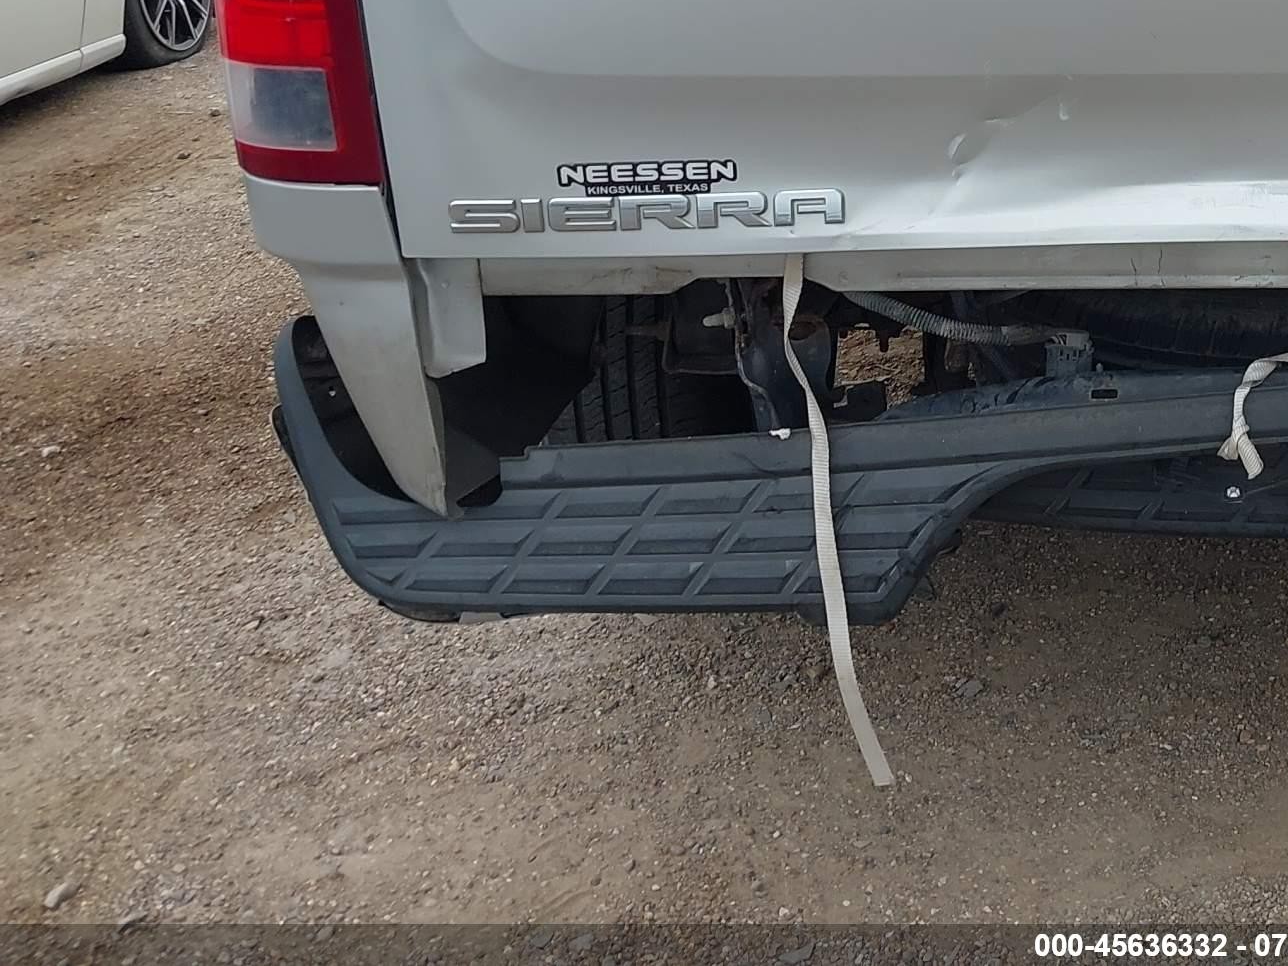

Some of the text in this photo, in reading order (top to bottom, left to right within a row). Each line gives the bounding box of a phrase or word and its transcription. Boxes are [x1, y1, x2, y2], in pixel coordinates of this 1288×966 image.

[559, 161, 735, 184] NEESSEN
[587, 183, 709, 195] KINGSVILLE, TEXAS
[449, 188, 845, 233] SIERRA
